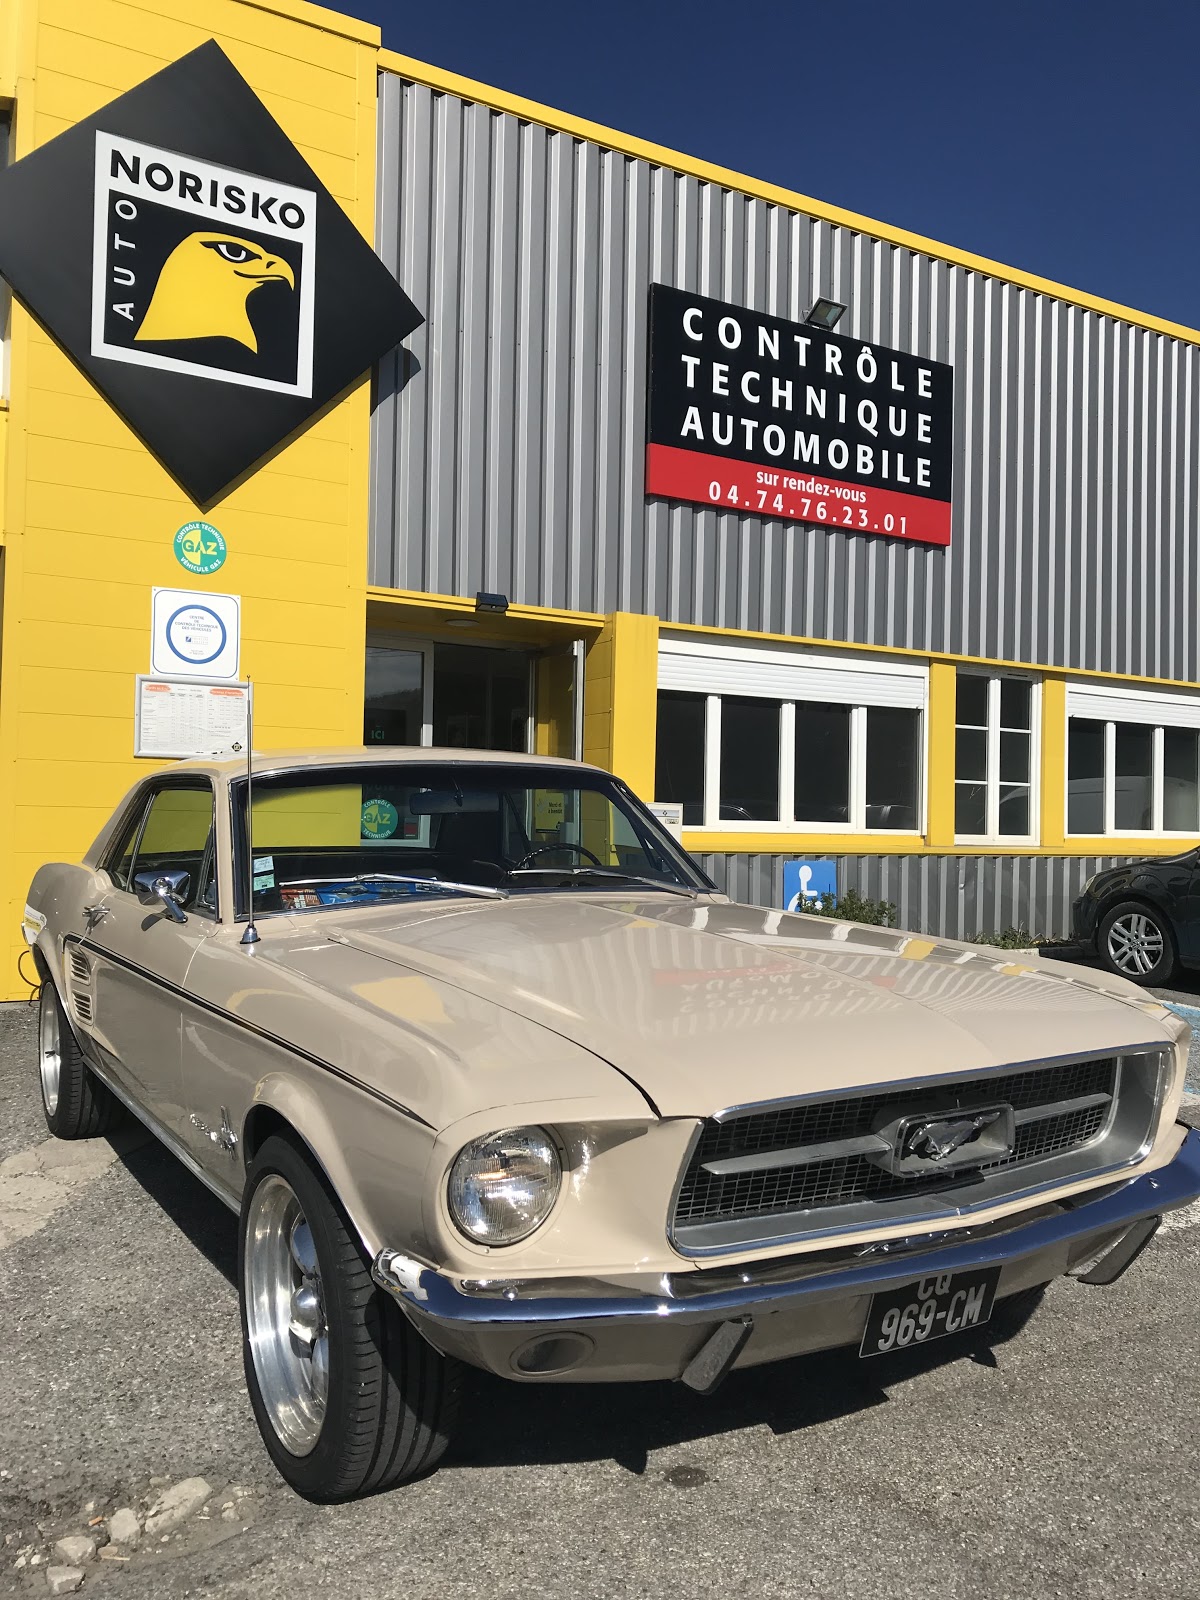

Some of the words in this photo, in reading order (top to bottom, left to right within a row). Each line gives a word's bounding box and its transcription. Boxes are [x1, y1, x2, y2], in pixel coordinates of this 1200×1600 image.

[110, 148, 306, 230] NORISKO
[112, 199, 138, 322] AUTO
[682, 307, 933, 399] CONTRÔLE
[681, 354, 932, 444] TECHNIQUE
[680, 405, 931, 488] AUTOMOBILE
[756, 471, 779, 487] sur
[782, 475, 867, 503] rendez-vous
[708, 481, 907, 534] 04.74.76.23.01
[176, 523, 200, 543] CONTRÔLE
[201, 524, 225, 551] TECHNIQUE
[182, 540, 217, 556] GAZ
[209, 558, 222, 570] GAZ
[371, 730, 385, 740] ICI
[364, 799, 391, 808] CONTRÔLE
[364, 812, 391, 825] GAZ
[363, 828, 392, 839] TECHNIQUE
[878, 1283, 987, 1351] 969-CM
